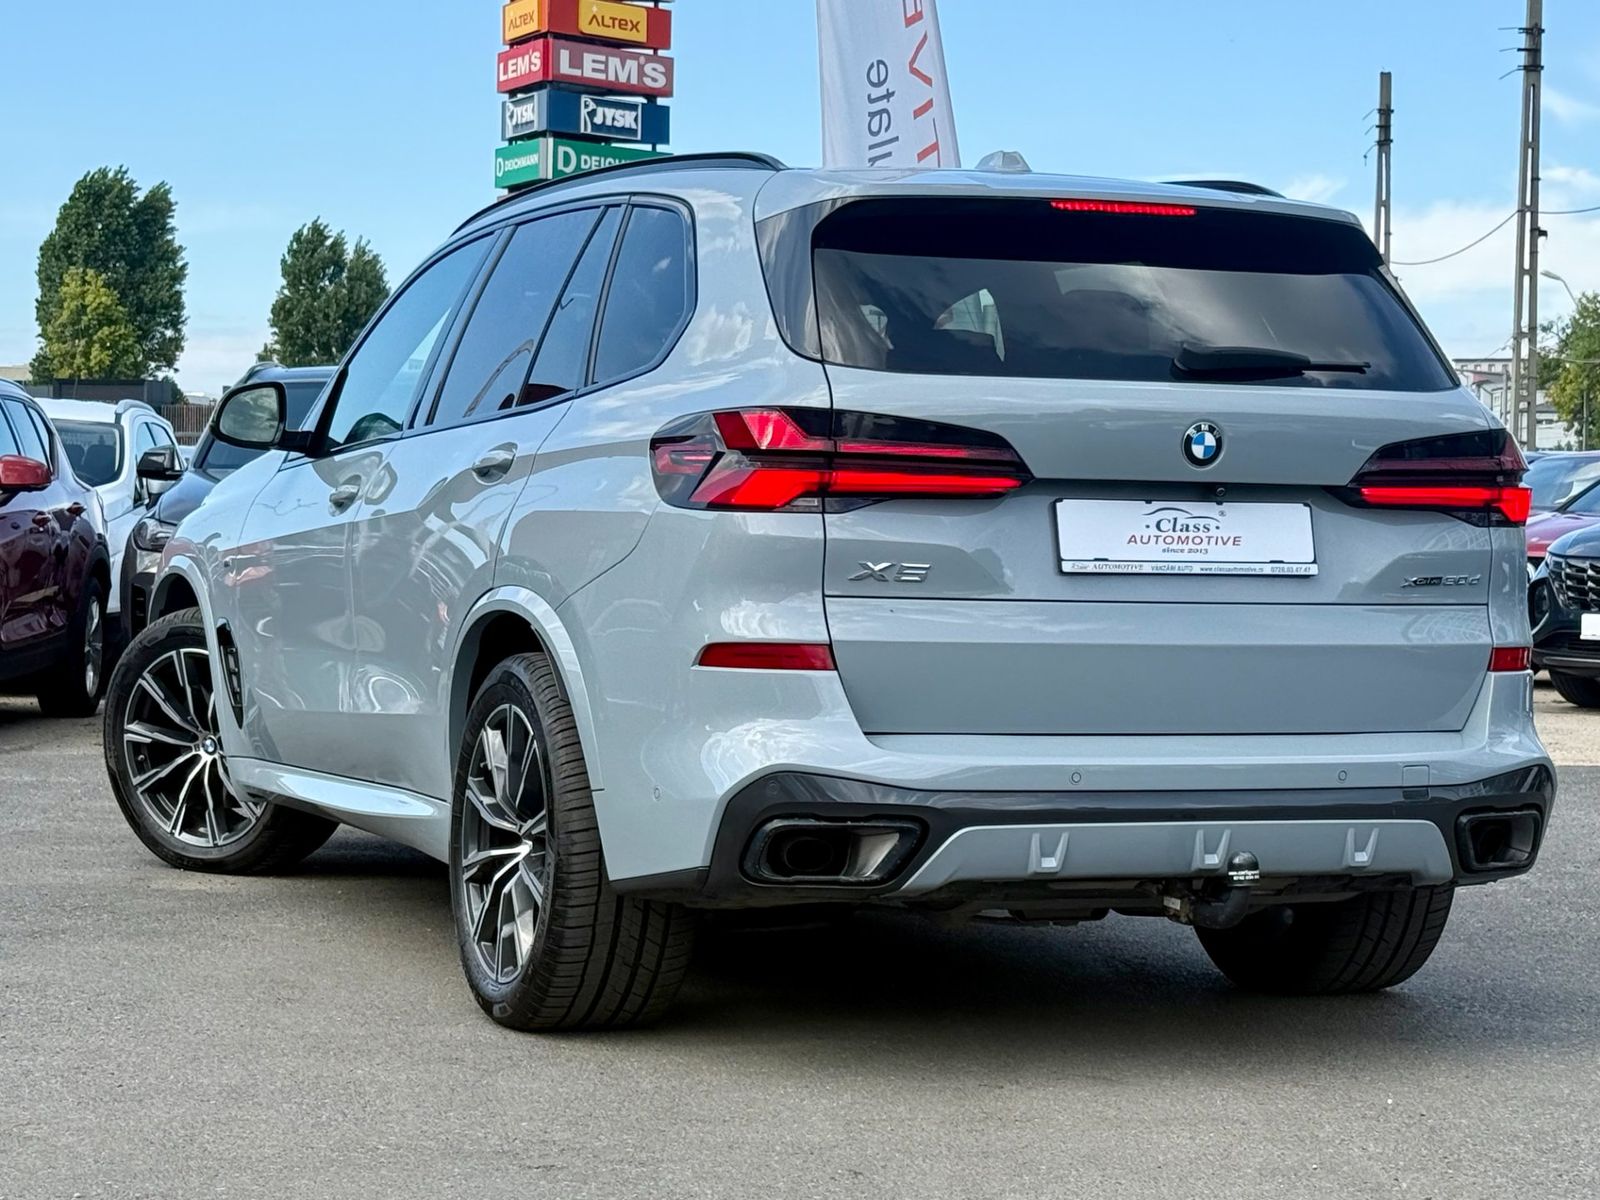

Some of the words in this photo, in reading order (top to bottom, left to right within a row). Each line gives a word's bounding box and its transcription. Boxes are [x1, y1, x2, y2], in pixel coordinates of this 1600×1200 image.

[499, 50, 542, 82] LEM'S
[559, 49, 667, 89] LEM'S
[511, 103, 535, 126] JYSK
[593, 106, 638, 130] JYSK
[505, 153, 539, 171] DEICHMANN
[1155, 516, 1211, 533] Class
[1126, 534, 1243, 547] AUTOMOTIVE
[1162, 546, 1185, 554] since
[1187, 547, 1209, 555] 2013
